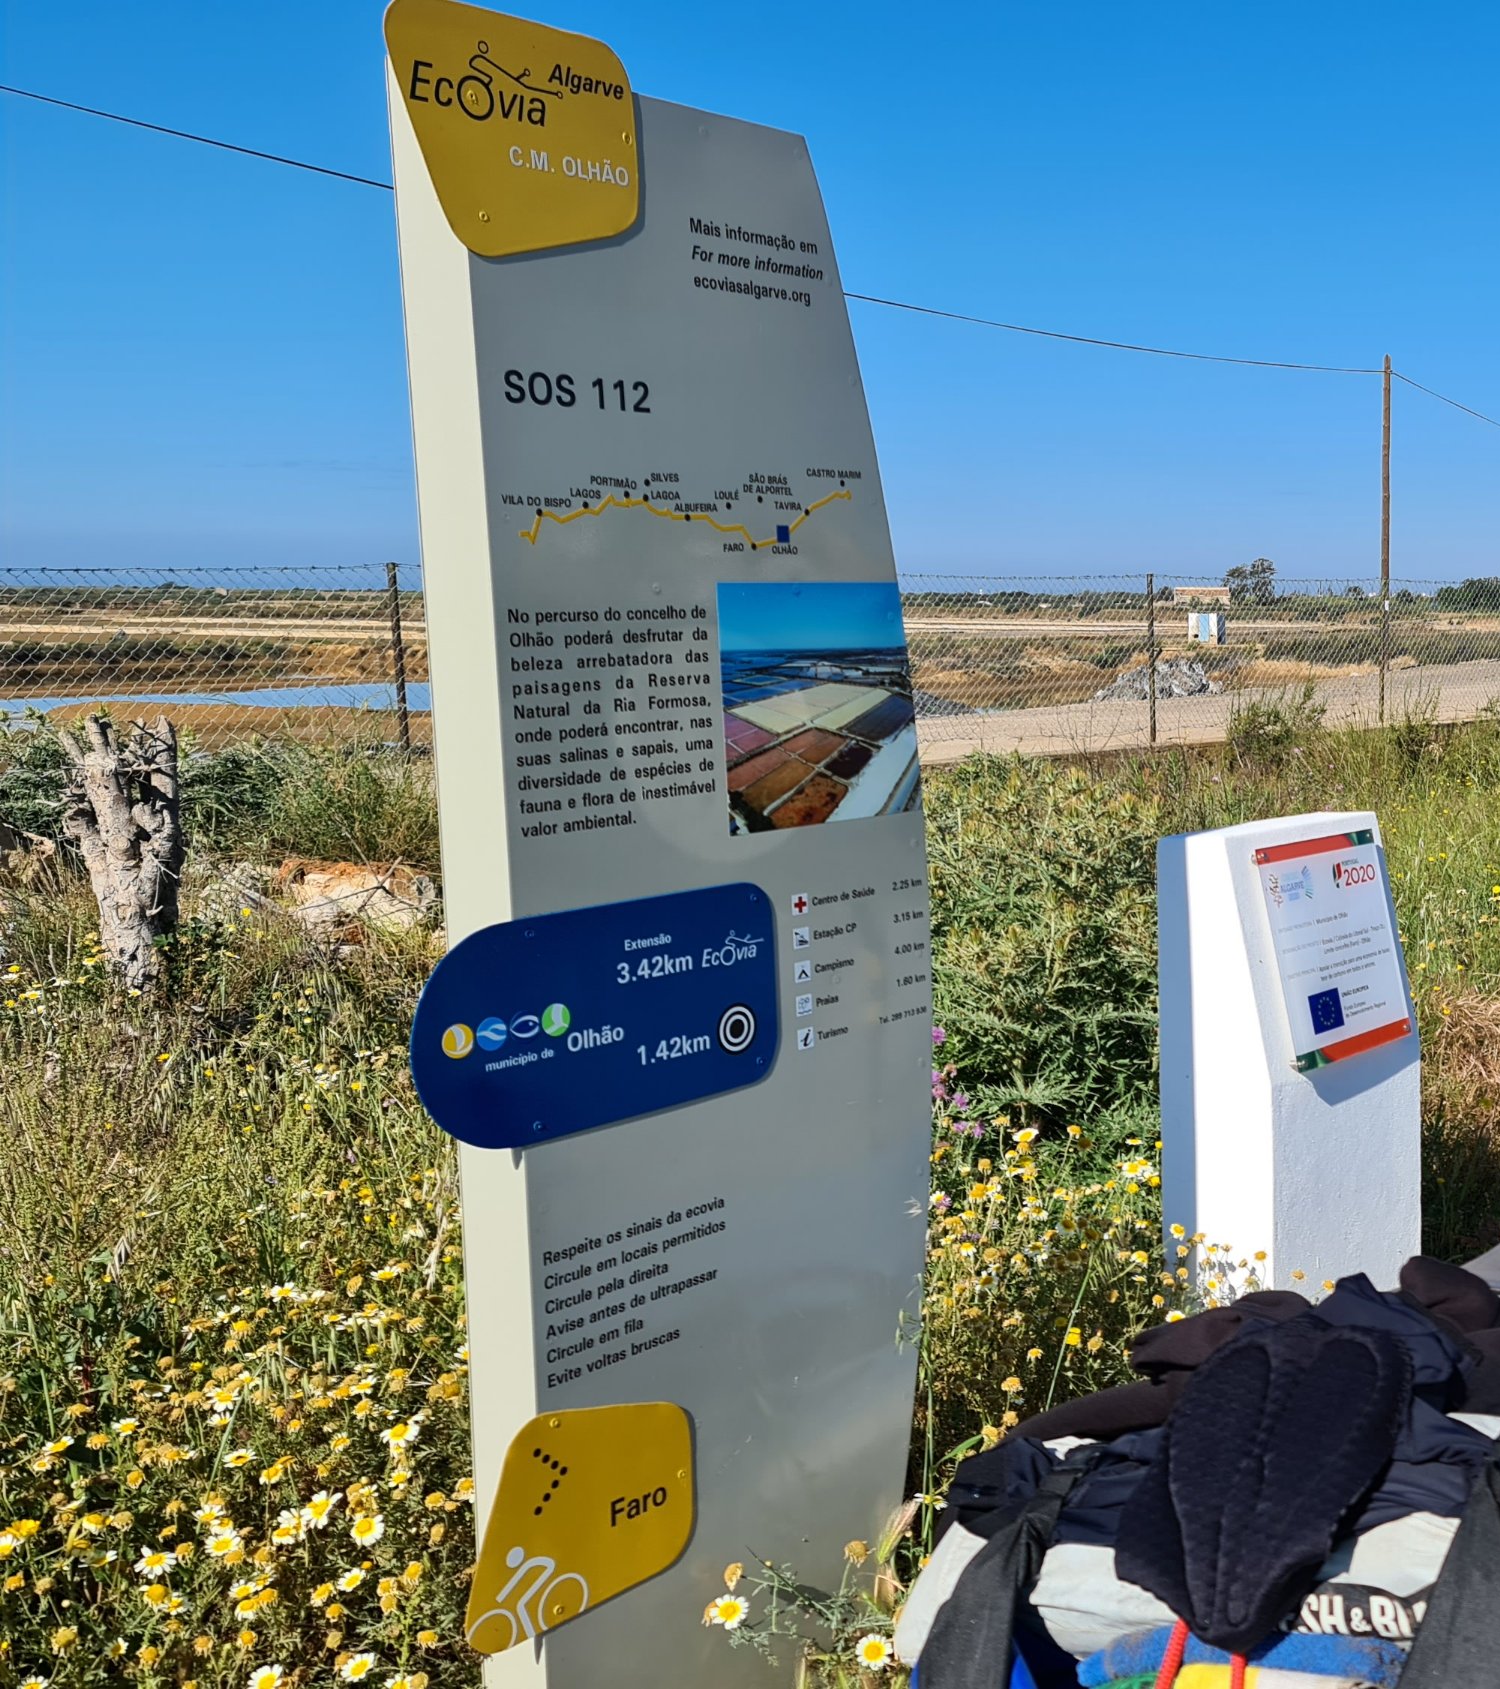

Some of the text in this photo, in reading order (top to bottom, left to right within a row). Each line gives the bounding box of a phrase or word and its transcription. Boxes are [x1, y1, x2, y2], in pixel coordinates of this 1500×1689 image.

[548, 63, 624, 100] Algarve
[509, 145, 629, 187] C.M. OLHÃO
[689, 217, 818, 255] Mais informação em
[691, 245, 823, 280] For more information
[694, 276, 811, 307] ecoviasalgarve.org
[503, 368, 652, 415] SOS 112
[590, 475, 637, 490] PORTIMÃO
[651, 473, 680, 483] SILVES
[749, 473, 788, 485] SÃO BRÁS
[806, 468, 861, 480] CASTRO MARIM
[501, 494, 572, 508] VILA DO BISPO
[570, 487, 601, 500] LAGOS
[651, 490, 680, 500] LAGOA
[714, 489, 739, 500] LOULÉ
[743, 484, 793, 496] DE ALPORTEL
[674, 503, 718, 513] ALBUFEIRA
[774, 501, 801, 511] TAVIRA
[723, 543, 744, 552] FARO
[772, 544, 798, 555] OLHÃO
[507, 605, 707, 626] No percurso do concelho de
[509, 627, 708, 649] Olhão poderá desfrutar da
[511, 649, 709, 672] beleza arrebatadora das
[512, 673, 711, 699] paisagens da Reserva
[513, 695, 711, 720] Natural da Ria Formosa,
[515, 716, 713, 744] onde poderá encontrar, nas
[516, 738, 713, 768] suas salinas e sapais, uma
[518, 758, 714, 791] diversidade de espécies de
[519, 778, 716, 815] fauna e flora de inestimável
[521, 811, 637, 838] valor ambiental.
[892, 878, 922, 891] 2.25 km
[1343, 863, 1376, 887] 2020
[812, 886, 875, 906] Centro de Saúde
[893, 910, 924, 923] 3.15 km
[624, 933, 672, 951] Extensão
[813, 922, 857, 940] Estação CP
[894, 942, 925, 955] 4.00 km
[616, 954, 694, 984] 3.42km
[814, 958, 854, 973] Campismo
[915, 974, 926, 983] km
[815, 994, 839, 1007] Praias
[541, 1048, 554, 1059] de
[567, 1024, 625, 1052] Olhão
[817, 1026, 848, 1040] Turismo
[636, 1034, 711, 1066] 1.42km
[542, 1197, 725, 1266] Respeite os sinais da ecovia
[544, 1220, 726, 1290] Circule em locais permitidos
[545, 1263, 669, 1315] Circule pela direita
[546, 1268, 718, 1339] Avise antes de ultrapassar
[546, 1318, 644, 1364] Circule em fila
[547, 1327, 680, 1388] Evite voltas bruscas
[610, 1486, 668, 1528] Faro
[1350, 1606, 1373, 1633] &
